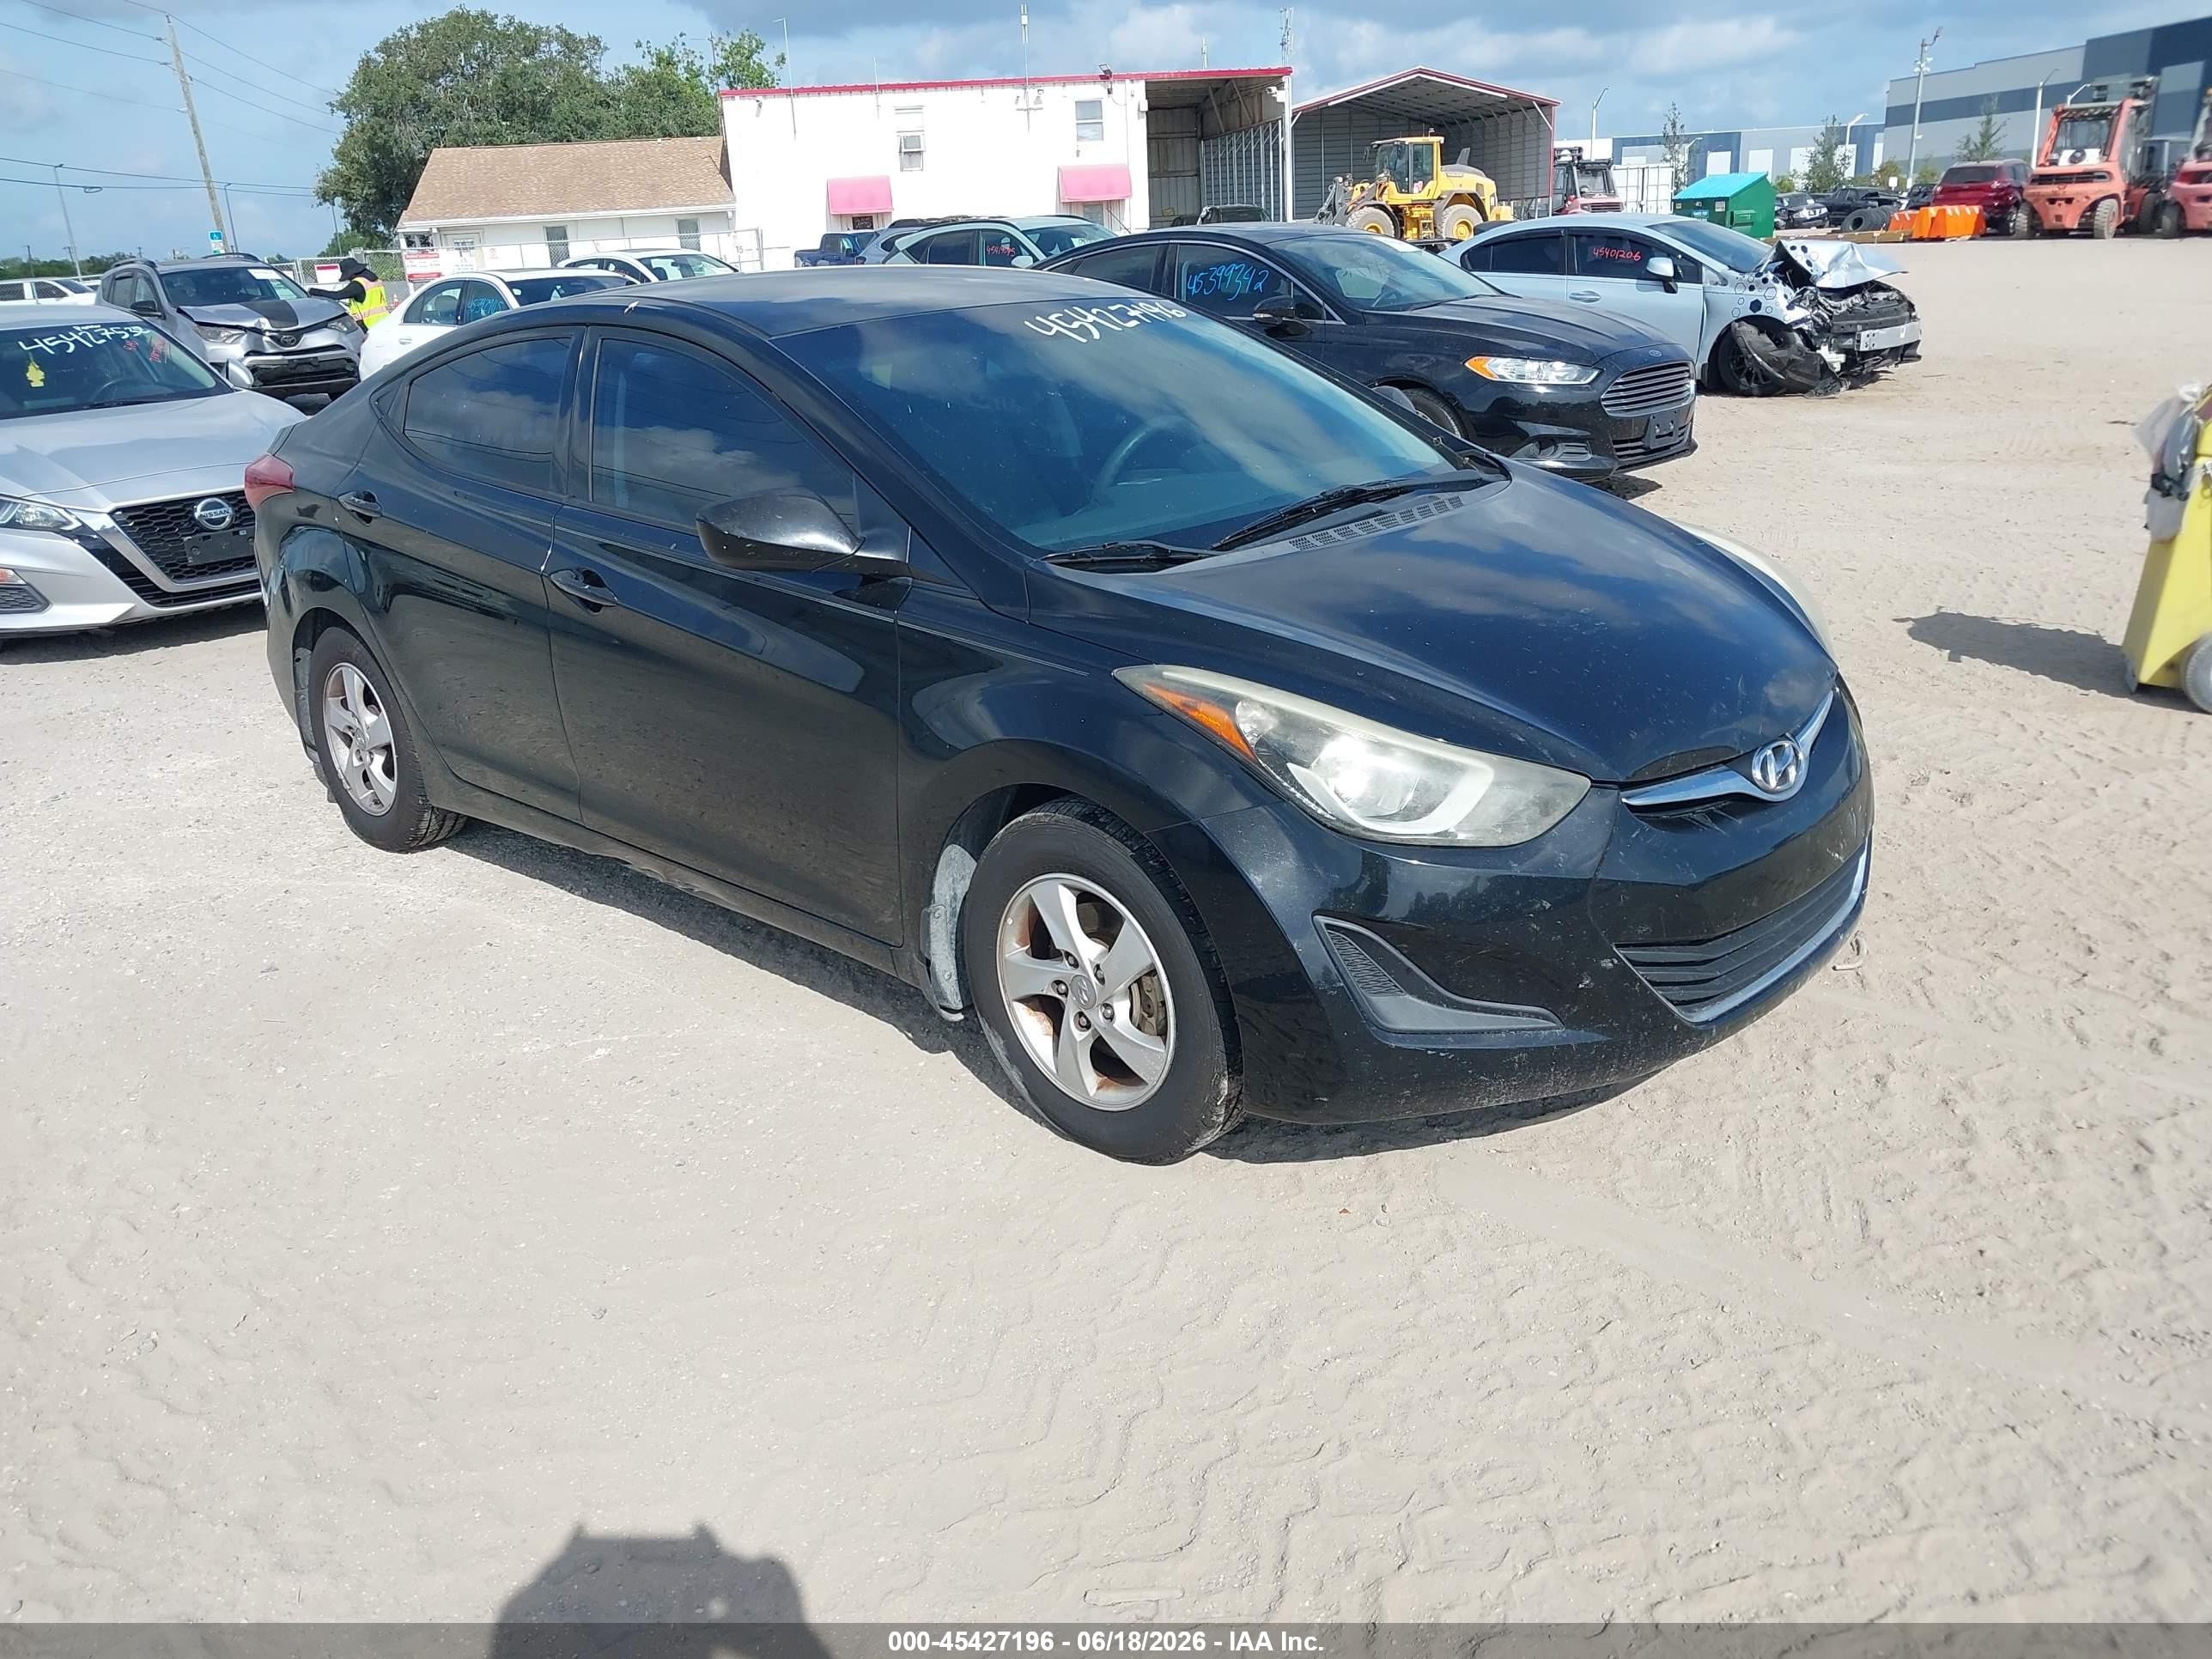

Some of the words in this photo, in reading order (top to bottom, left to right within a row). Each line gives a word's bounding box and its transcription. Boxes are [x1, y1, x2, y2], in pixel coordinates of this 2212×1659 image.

[1593, 246, 1642, 261] 45401206
[1187, 263, 1269, 301] 45399342
[1024, 301, 1188, 343] 45427196
[199, 509, 229, 518] NISSAN
